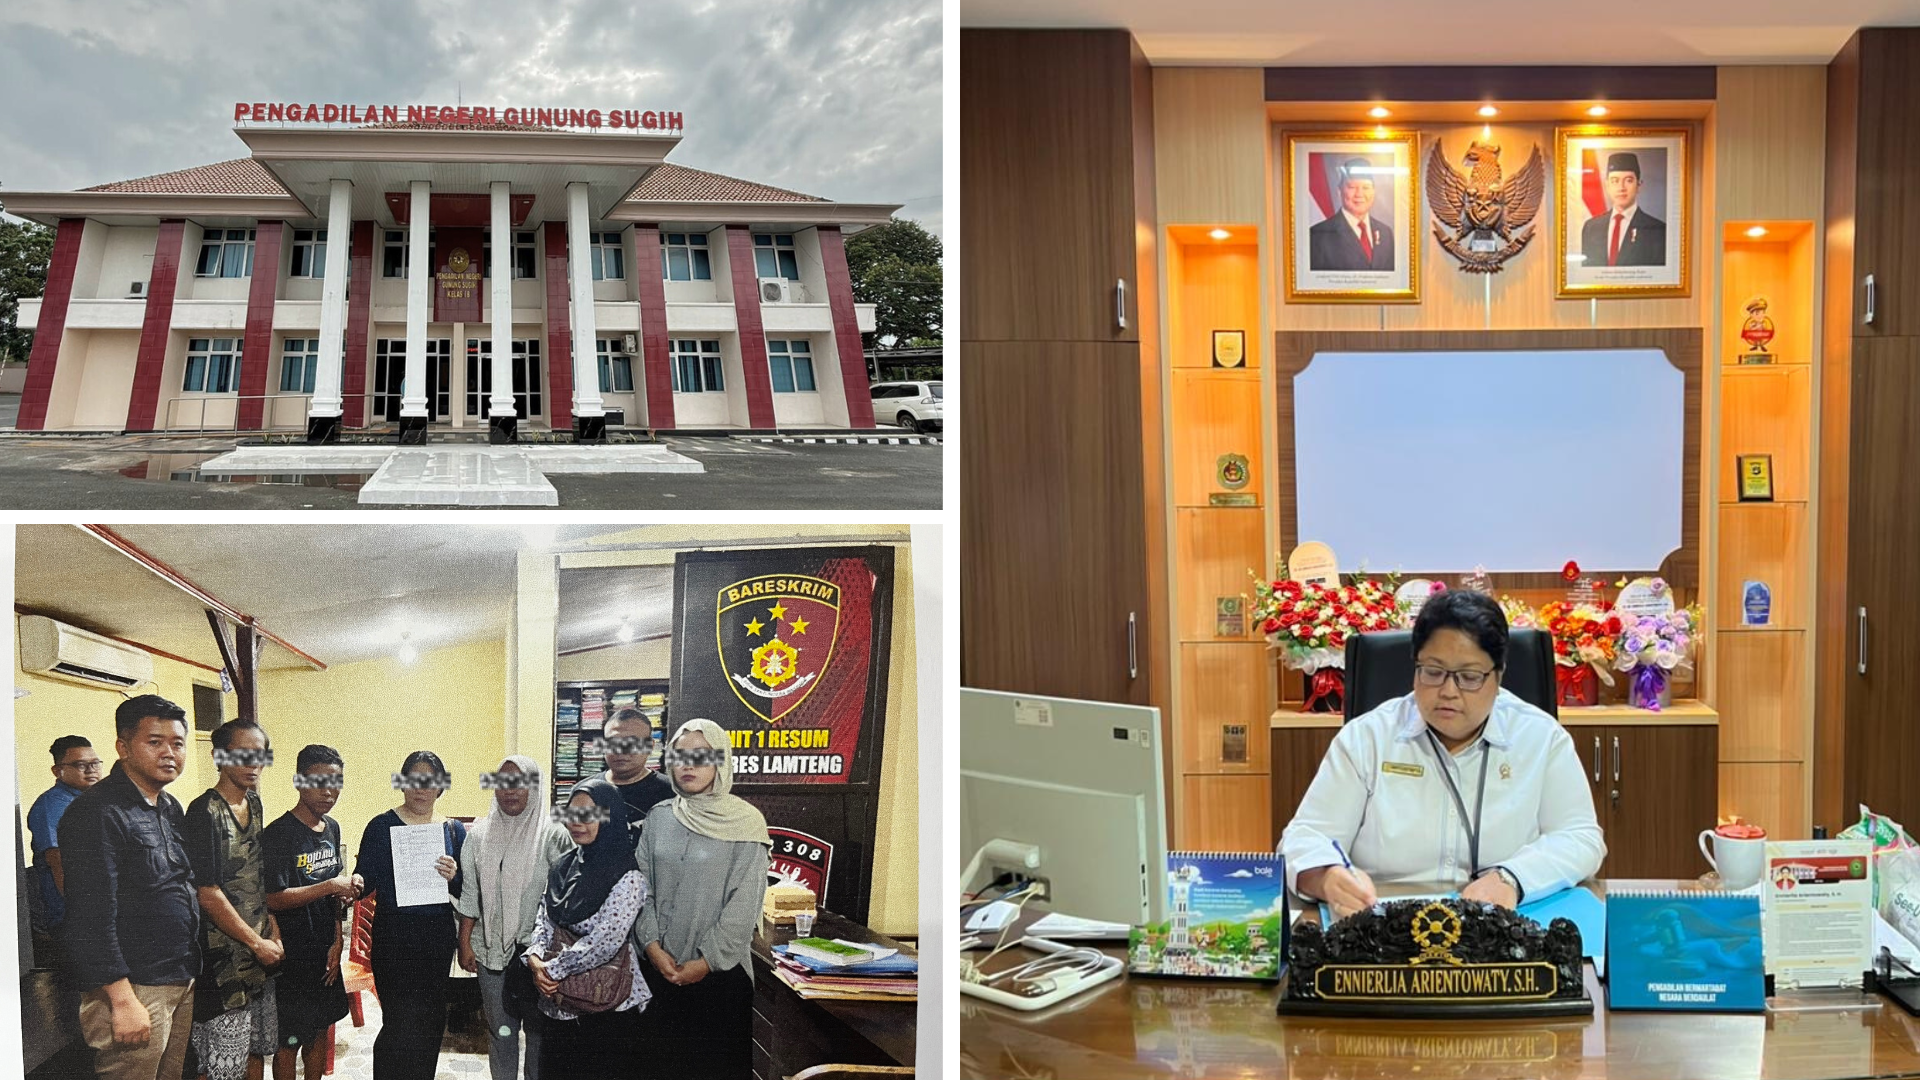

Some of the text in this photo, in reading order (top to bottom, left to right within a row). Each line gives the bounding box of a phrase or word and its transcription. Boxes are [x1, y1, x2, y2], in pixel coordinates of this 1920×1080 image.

[235, 103, 684, 130] PENGADILAN NEGERI GUNUNG SUGIH
[446, 290, 463, 298] KELAS
[727, 579, 834, 602] BARESKRIM
[725, 729, 829, 748] NIT 1 RESUM
[732, 755, 843, 774] RES LAMTENG
[782, 840, 822, 861] 308
[1334, 970, 1406, 993] ENNIERLIA
[1514, 969, 1539, 992] S.H.
